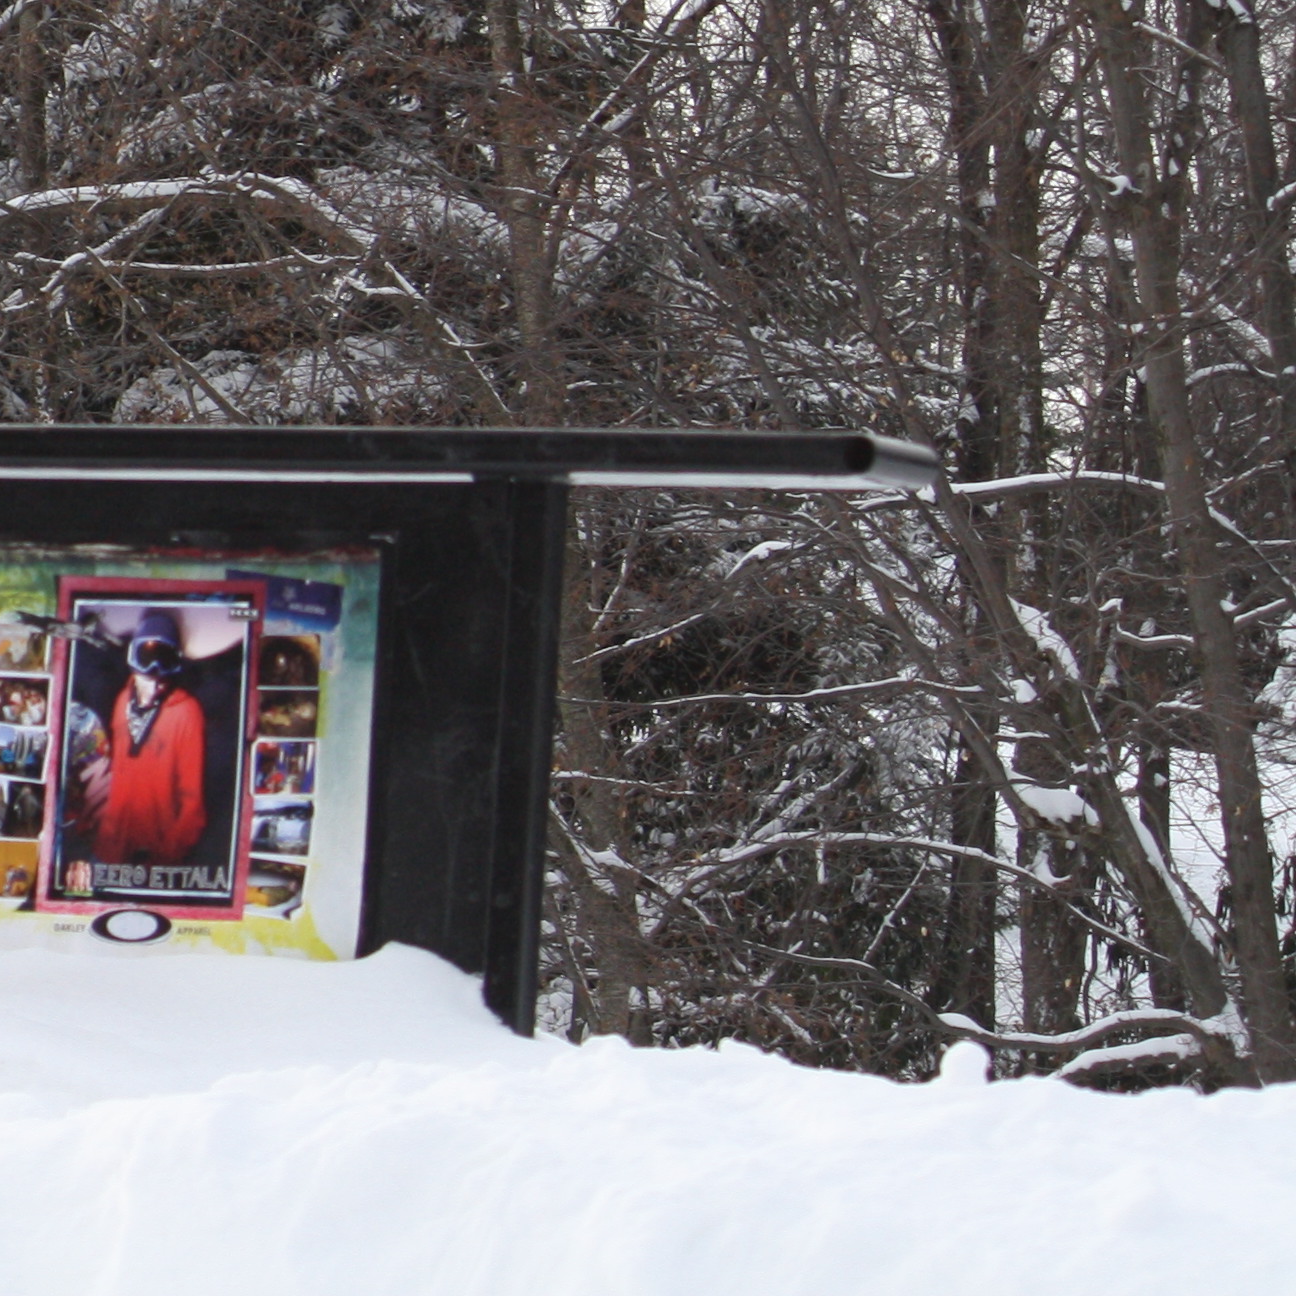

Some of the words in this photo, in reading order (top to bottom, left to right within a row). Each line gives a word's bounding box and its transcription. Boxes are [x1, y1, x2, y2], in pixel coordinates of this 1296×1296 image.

[94, 862, 147, 887] EERO
[149, 864, 228, 890] ETTALA
[53, 922, 86, 933] OAKLEY
